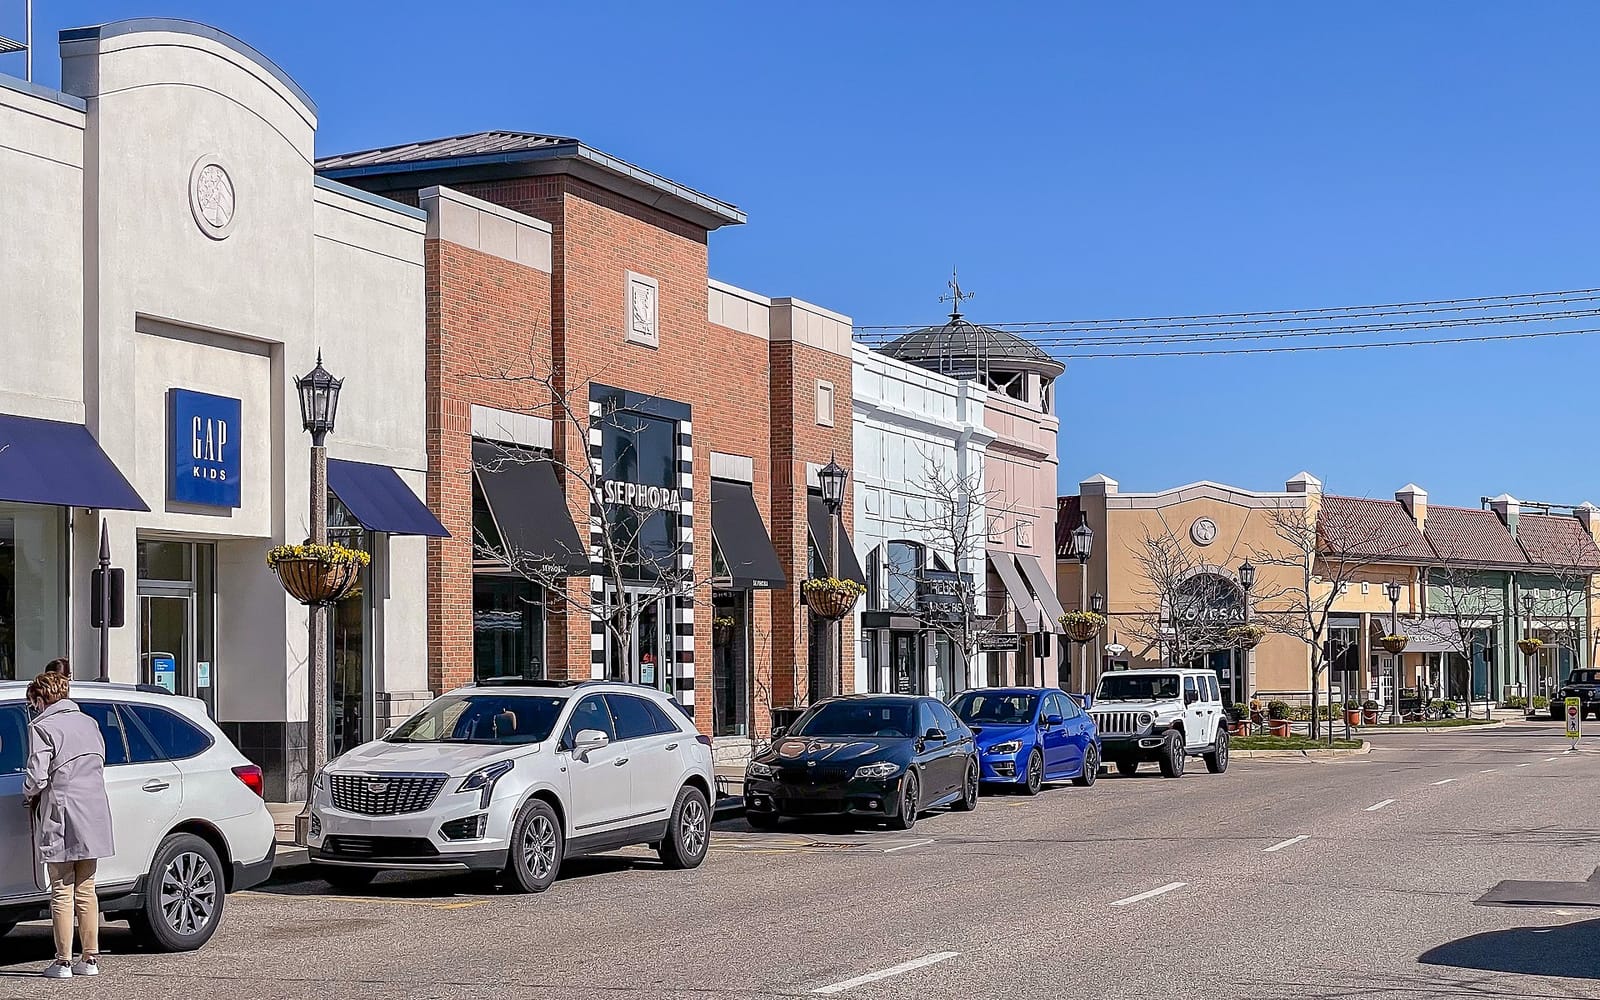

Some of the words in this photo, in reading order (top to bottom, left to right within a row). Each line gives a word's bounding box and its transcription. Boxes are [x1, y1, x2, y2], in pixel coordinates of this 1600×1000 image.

[193, 416, 227, 462] GAP
[193, 466, 226, 480] KIDS
[604, 480, 680, 511] SEPHORA
